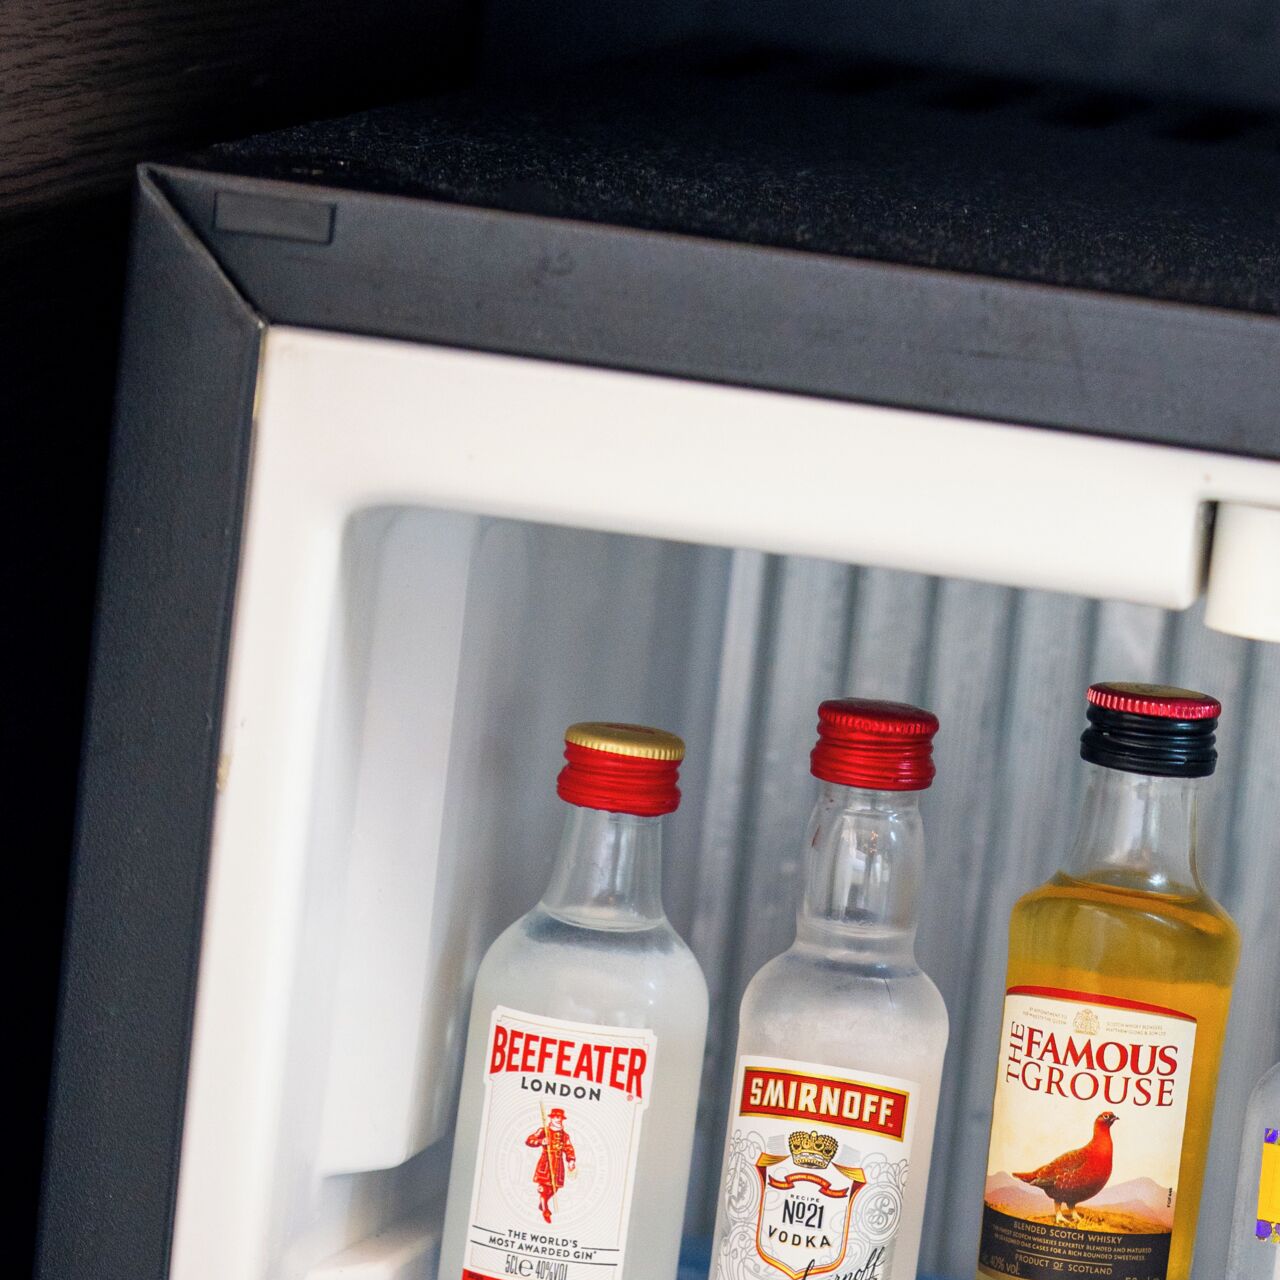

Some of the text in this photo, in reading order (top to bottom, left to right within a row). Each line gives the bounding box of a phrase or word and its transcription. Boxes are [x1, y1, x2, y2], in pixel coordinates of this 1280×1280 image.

[489, 1025, 647, 1098] BEEFEATER
[1006, 1021, 1025, 1083] THE
[1024, 1026, 1179, 1077] FAMOUS
[521, 1076, 602, 1101] LONDON
[1021, 1061, 1175, 1107] GROUSE
[750, 1077, 894, 1126] SMIRNOFF
[790, 1194, 820, 1203] RECIPE
[508, 1230, 578, 1248] THE WORLD'S
[768, 1224, 831, 1248] VODKA
[1014, 1221, 1047, 1236] BLENDED
[1050, 1229, 1084, 1241] SCOTCH
[1088, 1234, 1123, 1245] WHISKY
[489, 1236, 515, 1249] MOST
[517, 1243, 570, 1258] AWARDED
[1015, 1253, 1113, 1276] PRODUCT OF SCOTLAND
